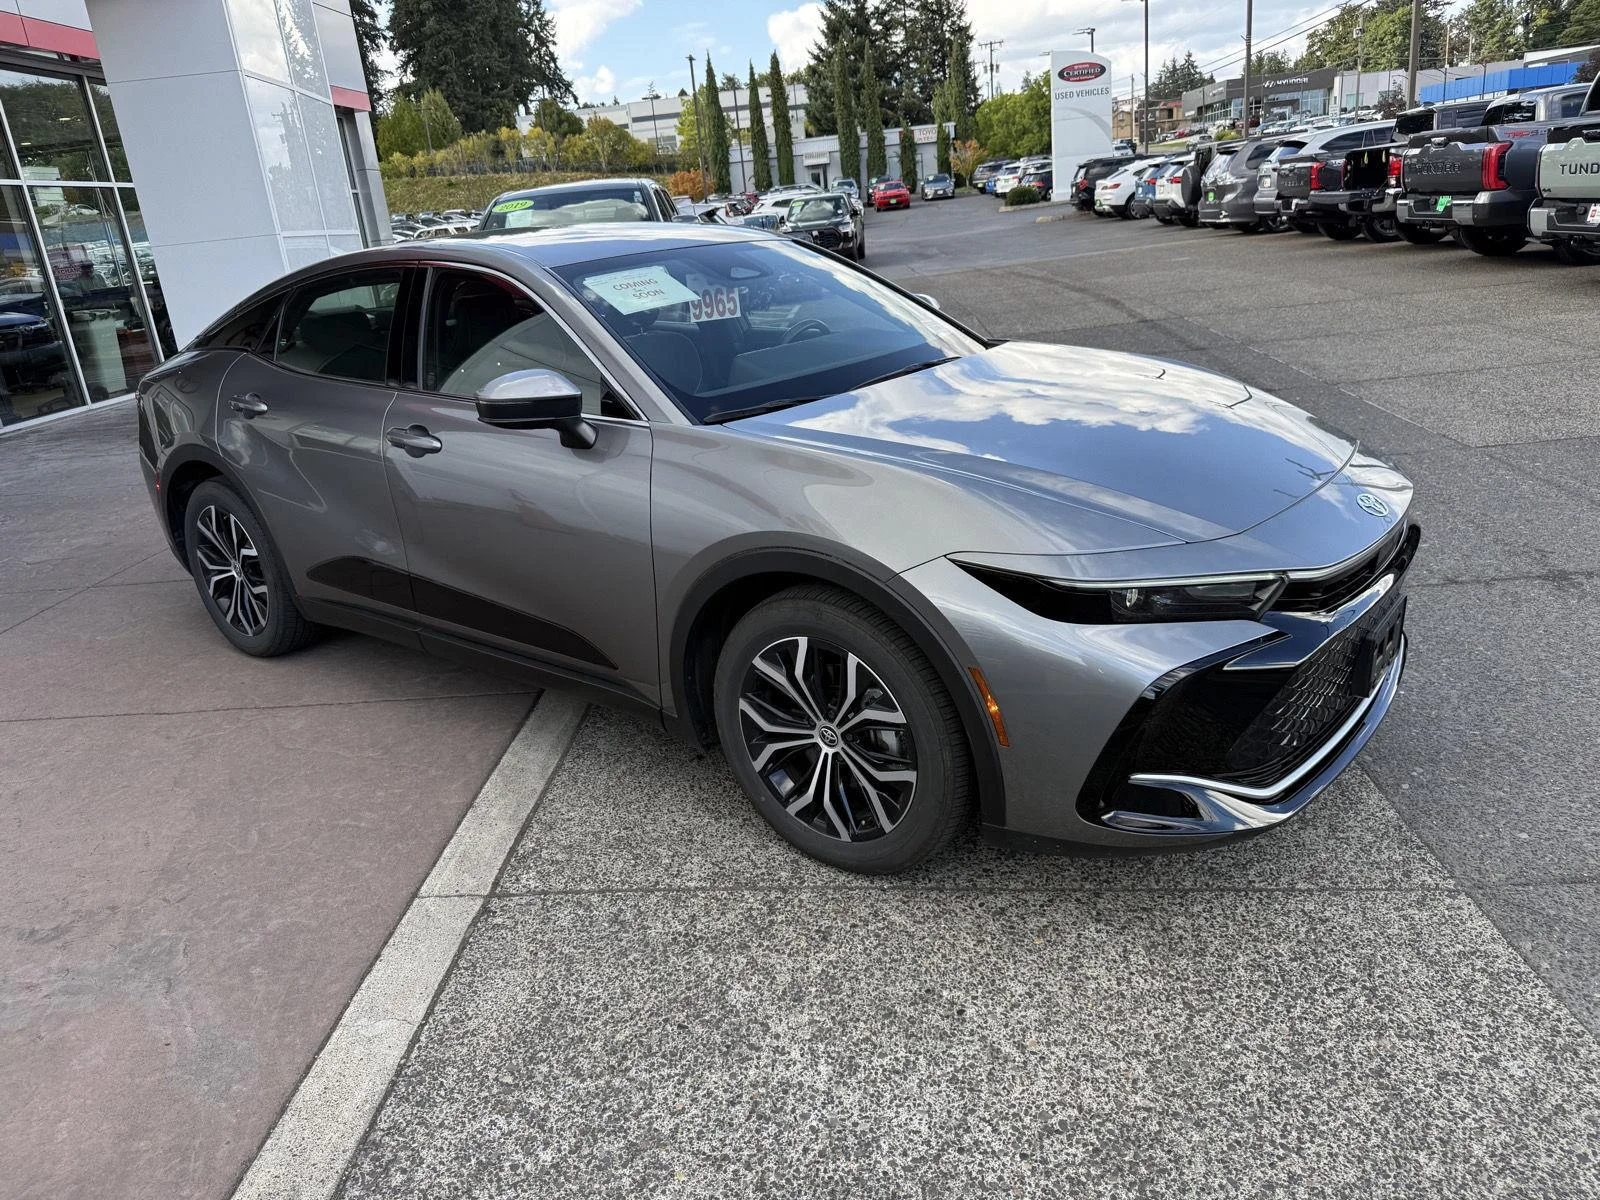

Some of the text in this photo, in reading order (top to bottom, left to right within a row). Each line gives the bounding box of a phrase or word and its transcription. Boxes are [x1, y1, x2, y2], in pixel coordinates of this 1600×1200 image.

[1064, 67, 1101, 77] CERTIFIED
[1055, 87, 1110, 100] USED VEHICLES
[919, 127, 937, 136] TOYO
[1415, 160, 1462, 175] TUNDRA
[1559, 162, 1600, 175] TUND
[612, 278, 659, 291] COMING
[632, 288, 665, 299] SOON
[690, 287, 738, 321] 9965
